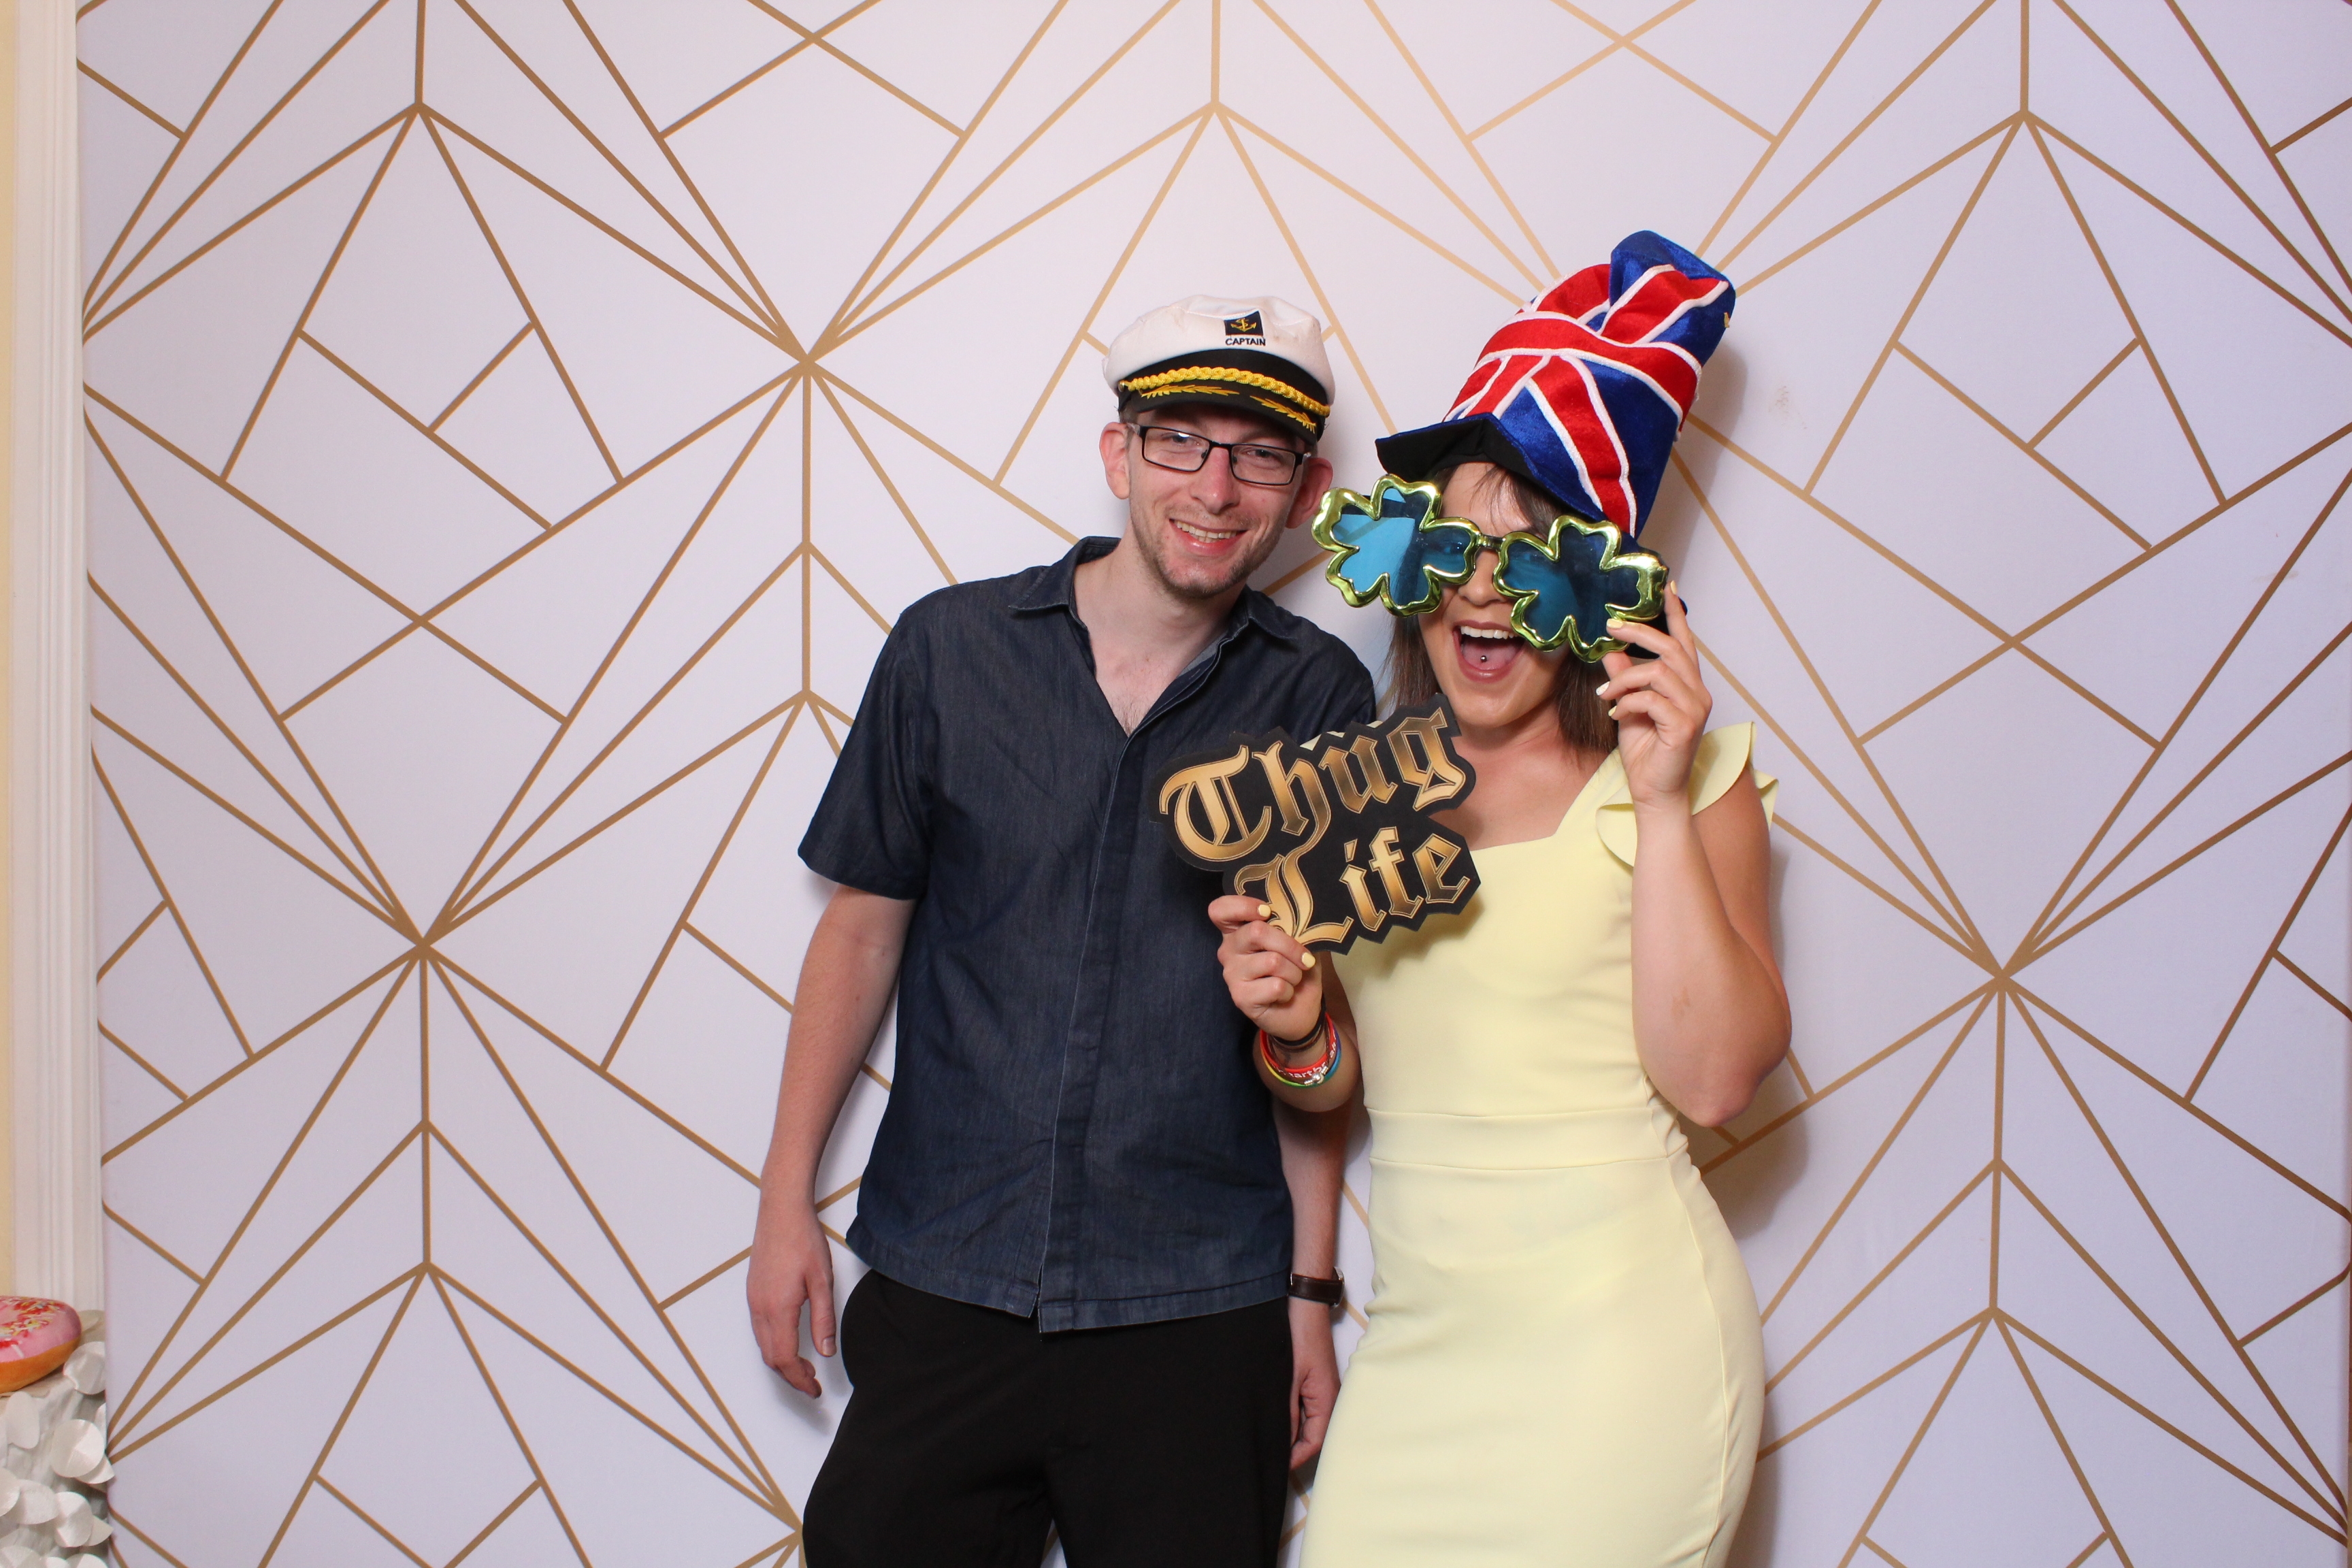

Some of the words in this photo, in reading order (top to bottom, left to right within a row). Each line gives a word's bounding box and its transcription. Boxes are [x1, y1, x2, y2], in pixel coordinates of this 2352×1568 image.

[1225, 338, 1266, 346] CAPTAIN
[1158, 706, 1467, 862] Thug
[1233, 826, 1471, 945] Life
